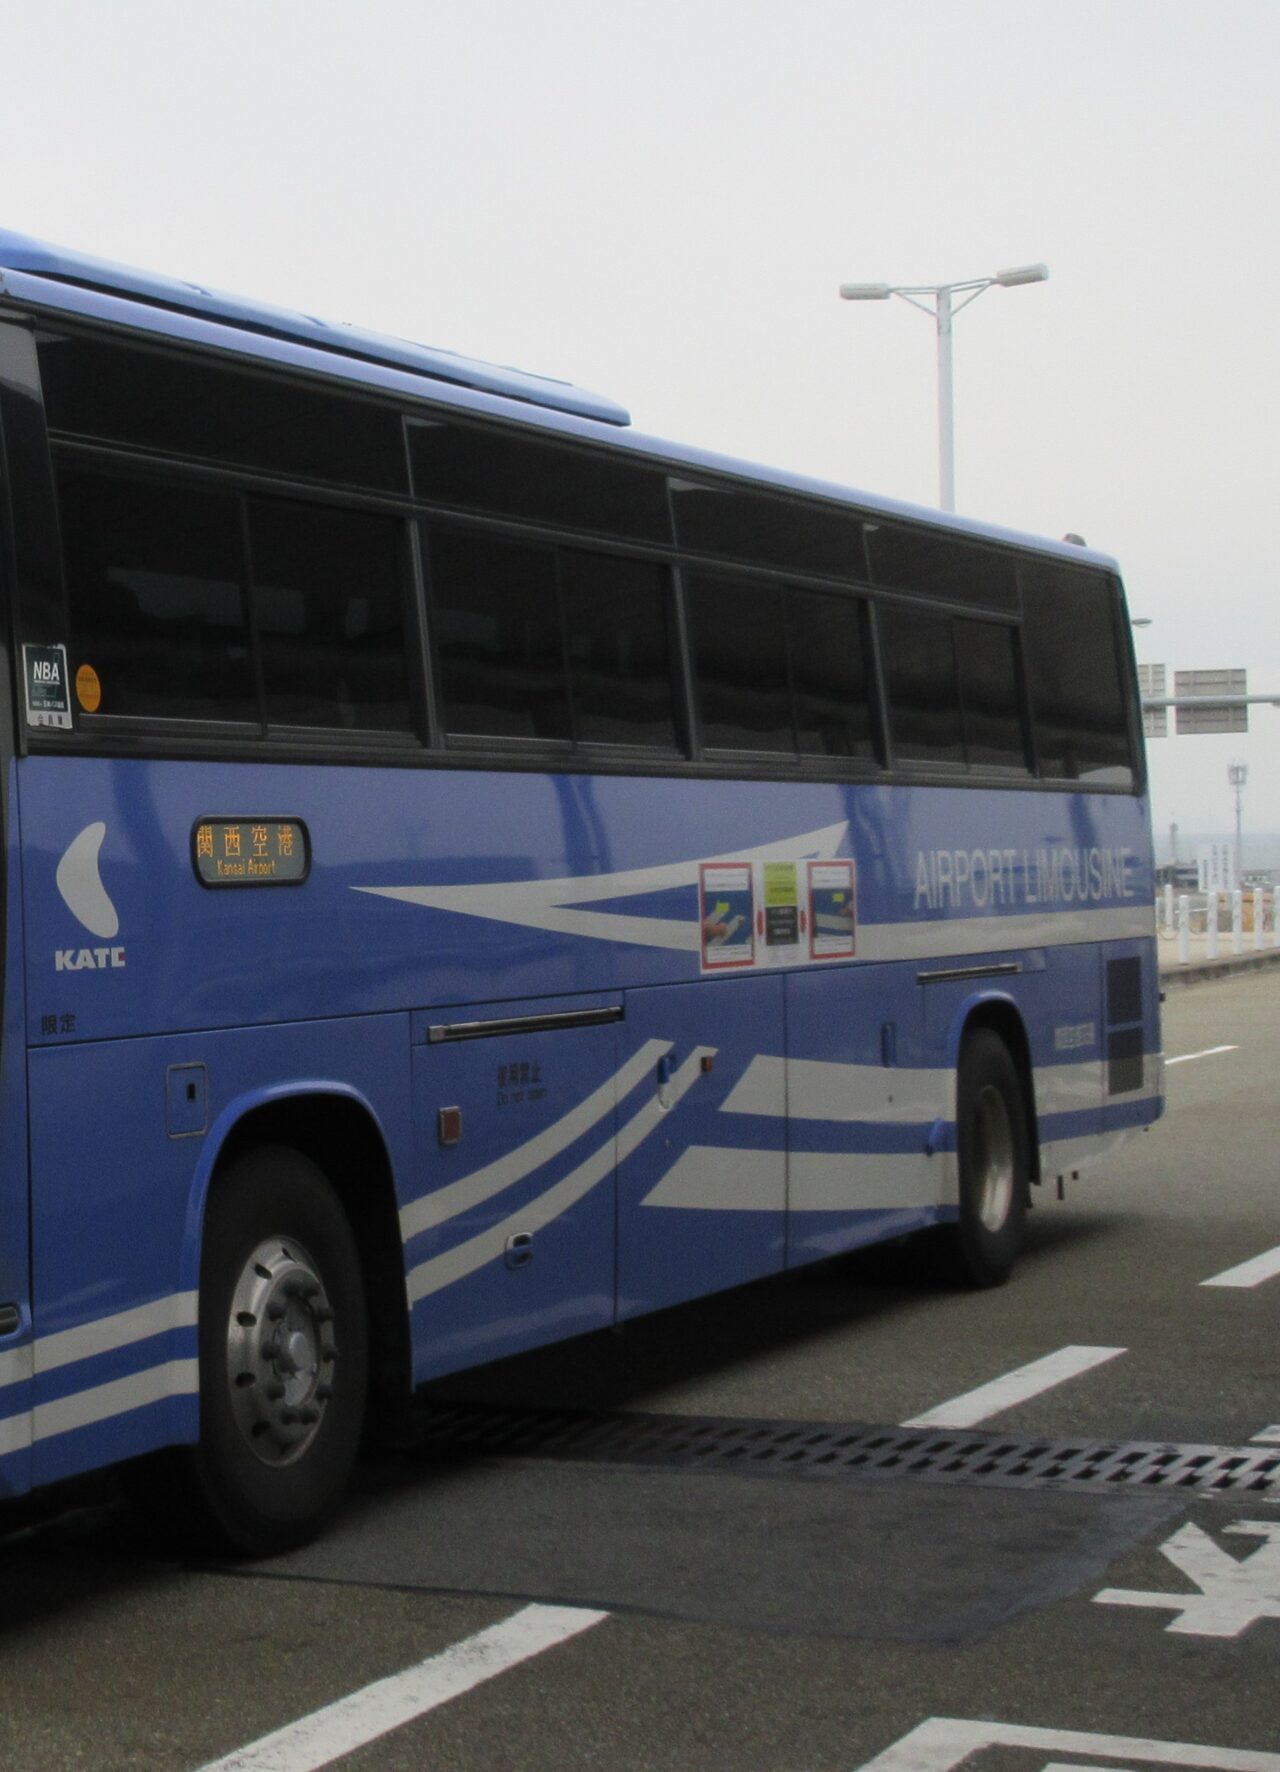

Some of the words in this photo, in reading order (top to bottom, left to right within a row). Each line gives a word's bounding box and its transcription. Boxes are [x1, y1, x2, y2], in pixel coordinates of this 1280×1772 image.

[33, 661, 60, 681] NBA
[197, 825, 293, 857] 関西空港
[217, 859, 245, 875] Kansai
[248, 858, 276, 874] Airport
[914, 850, 1018, 909] AIRPORT
[1024, 847, 1135, 903] LIMOUSINE
[41, 1013, 76, 1036] 限定
